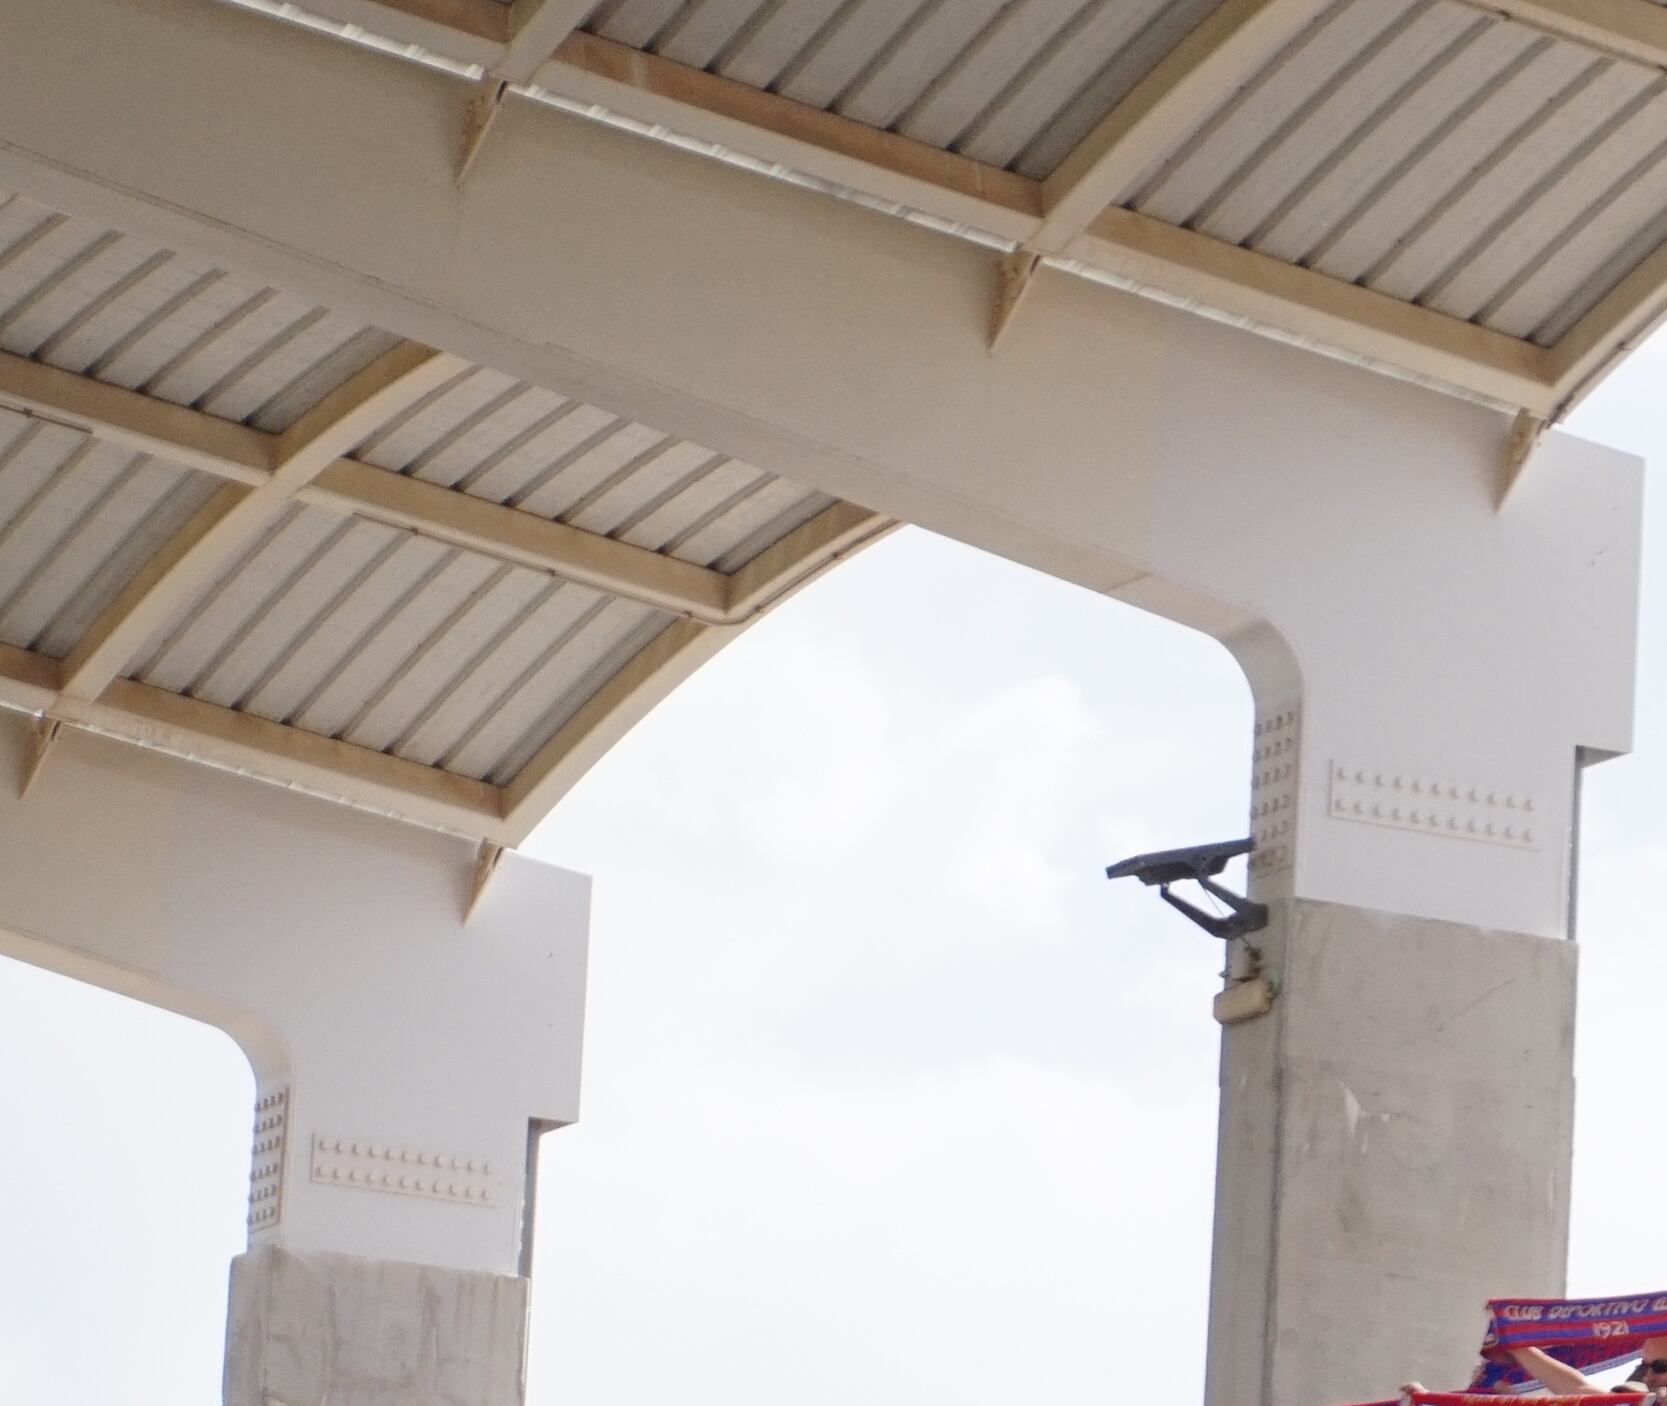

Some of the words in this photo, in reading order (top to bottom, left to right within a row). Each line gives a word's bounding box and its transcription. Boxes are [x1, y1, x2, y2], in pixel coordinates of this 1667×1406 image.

[1504, 1303, 1542, 1321] CLUB
[1548, 1299, 1648, 1319] DEPORTIVO
[1591, 1321, 1629, 1338] 1921
